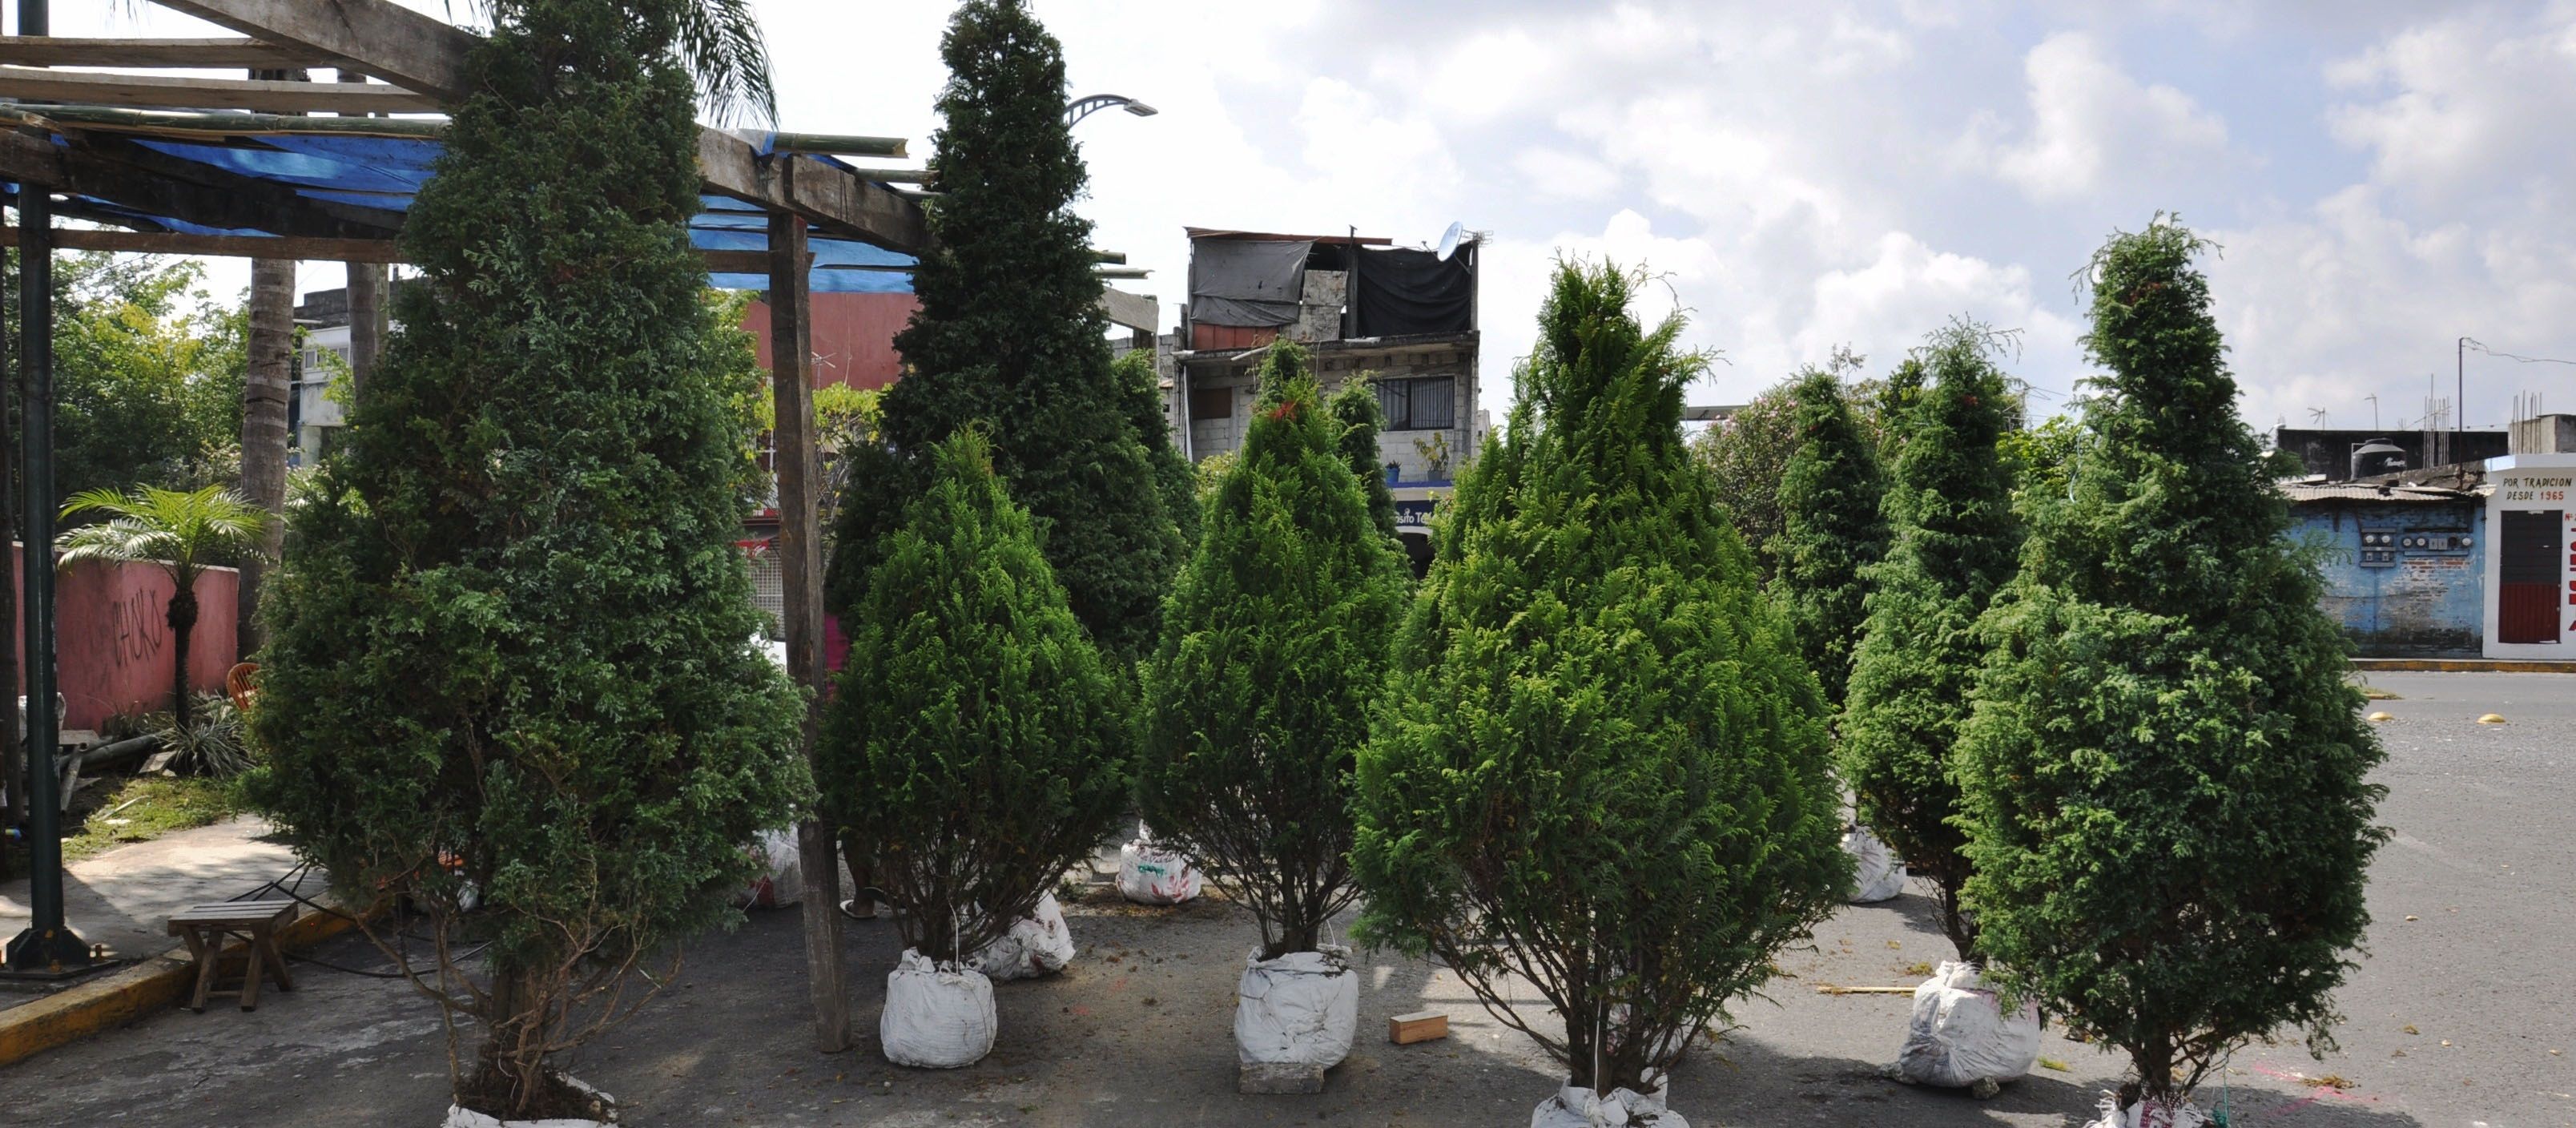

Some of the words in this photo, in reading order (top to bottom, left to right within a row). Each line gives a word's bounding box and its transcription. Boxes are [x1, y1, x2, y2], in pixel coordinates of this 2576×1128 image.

[2503, 477, 2519, 488] POR
[2522, 477, 2573, 488] TRADICION
[2506, 491, 2534, 500] DESDE
[2540, 491, 2564, 500] 1965
